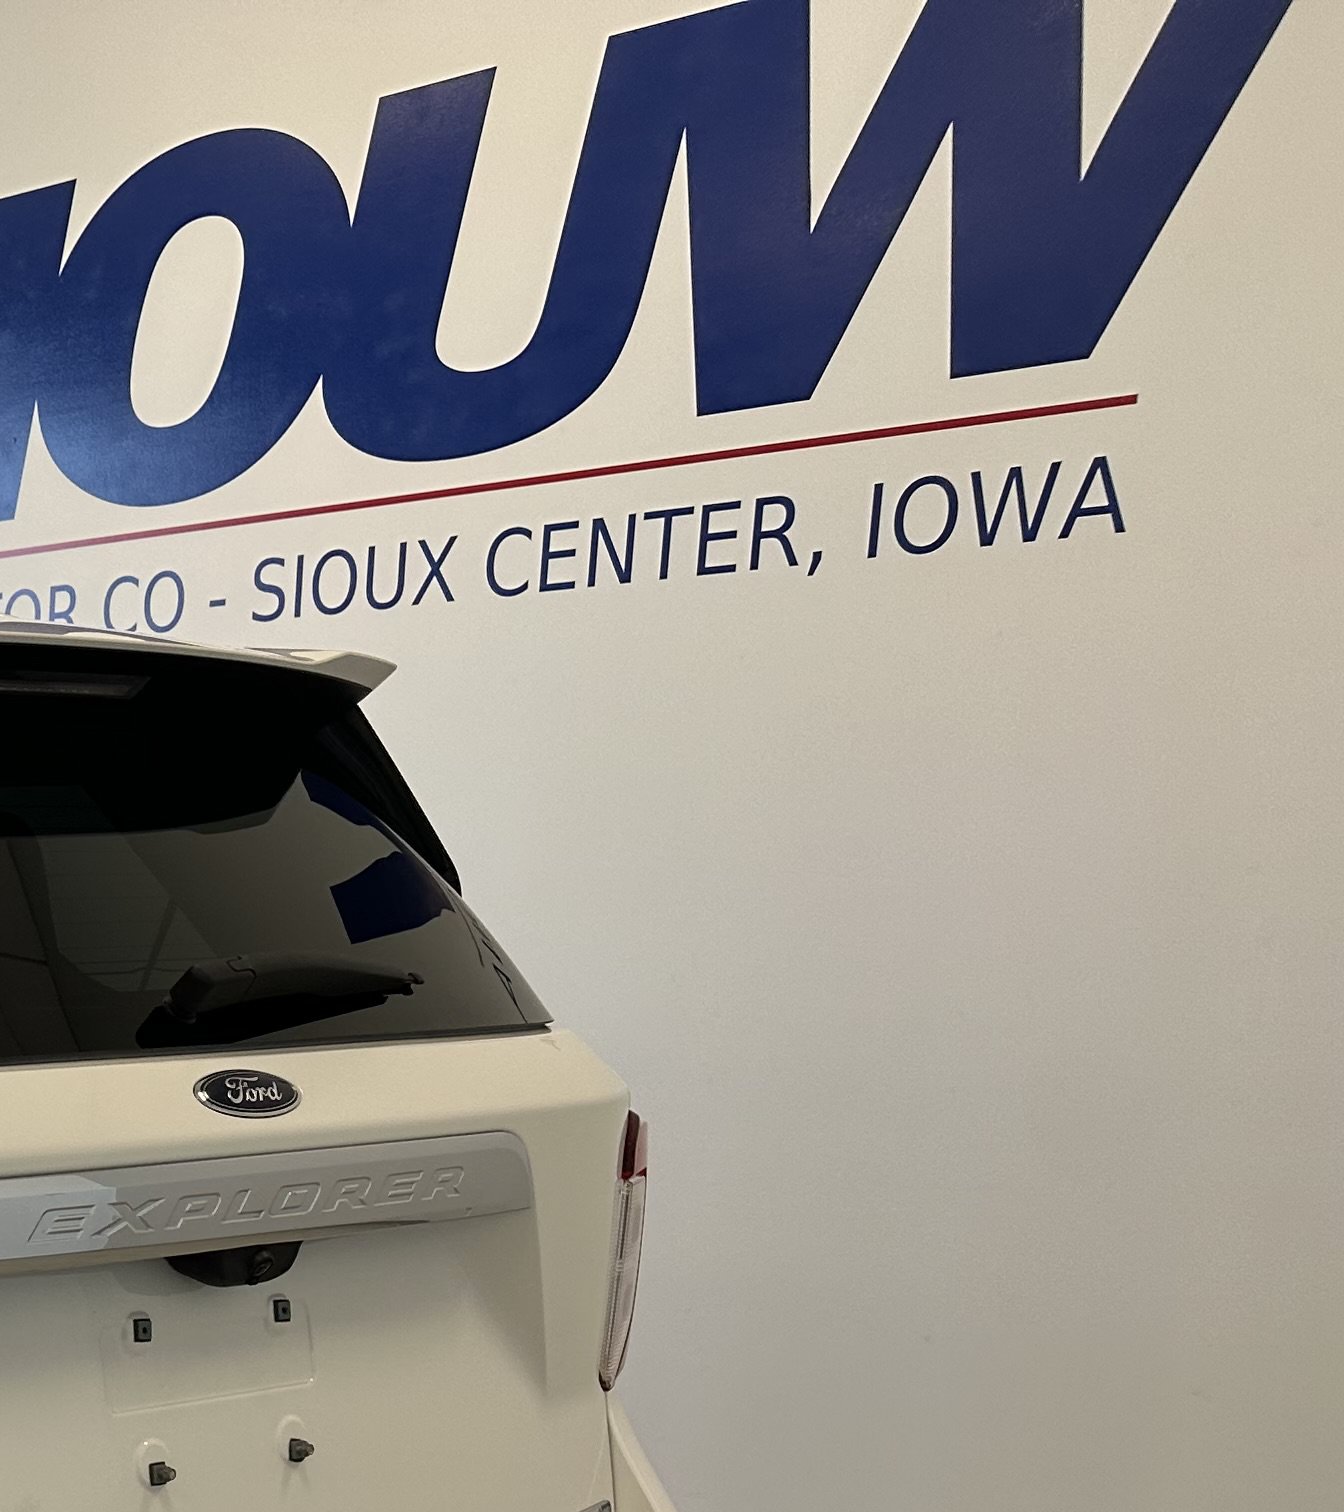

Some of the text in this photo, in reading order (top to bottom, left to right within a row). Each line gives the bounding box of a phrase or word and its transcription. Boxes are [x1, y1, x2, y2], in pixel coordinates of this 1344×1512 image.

[103, 569, 185, 633] CO
[251, 535, 459, 623] SIOUX
[485, 495, 824, 598] CENTER,
[866, 455, 1128, 560] IOWA
[225, 1074, 283, 1106] Ford
[26, 1164, 466, 1247] EXPLORER
